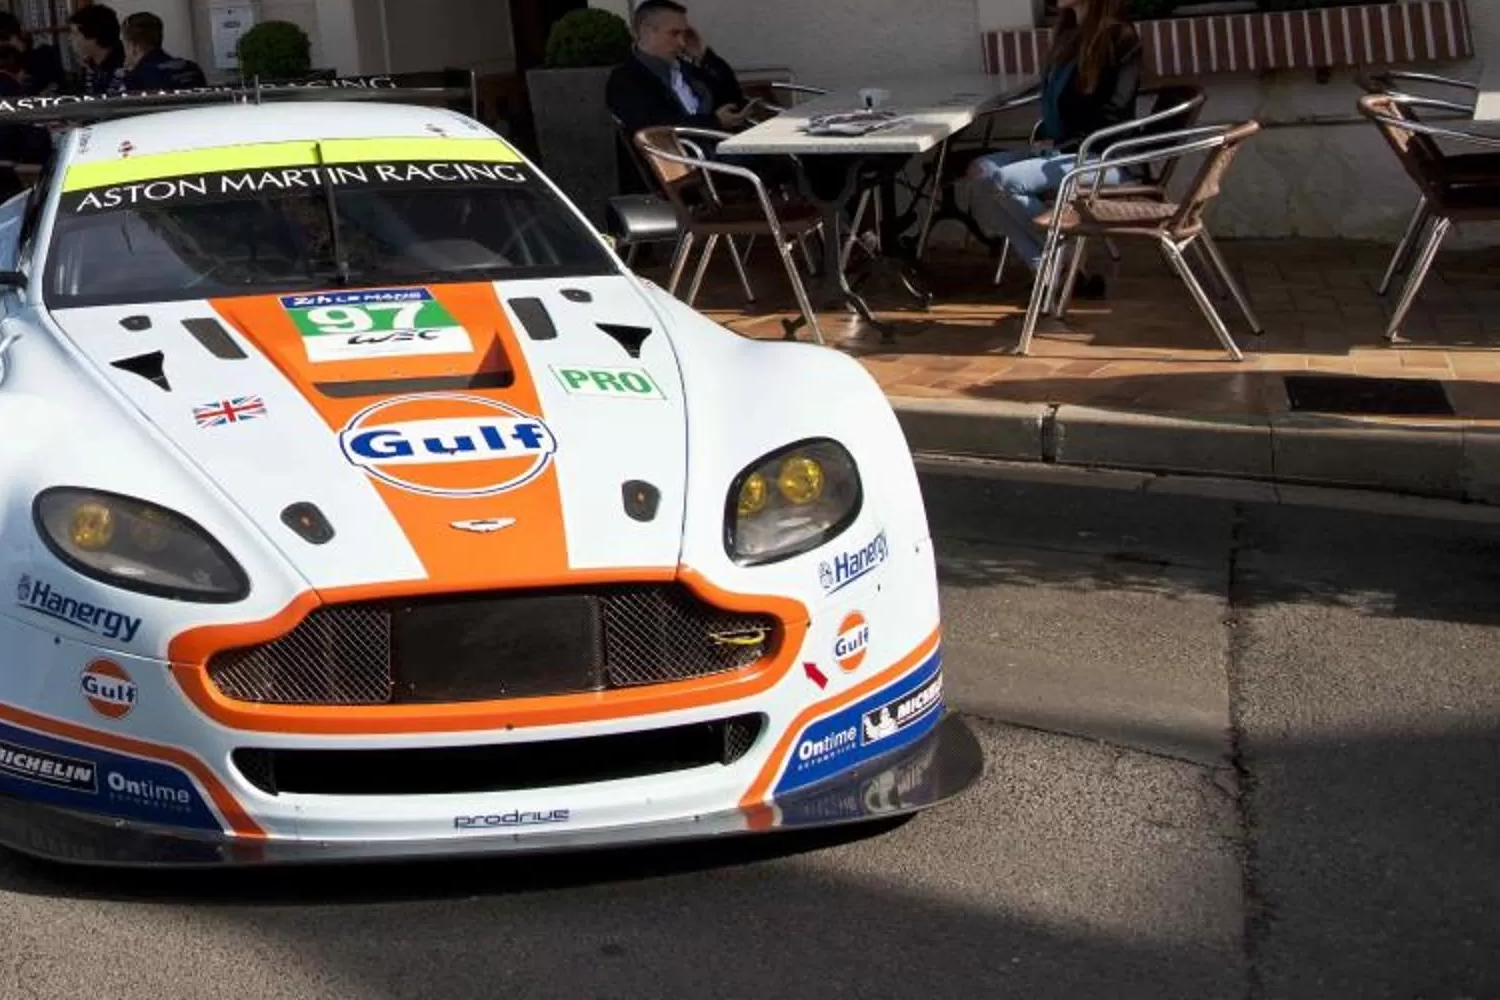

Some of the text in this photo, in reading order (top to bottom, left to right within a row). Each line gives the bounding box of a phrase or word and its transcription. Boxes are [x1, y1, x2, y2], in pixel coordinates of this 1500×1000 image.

[76, 163, 525, 212] ASTON MARTIN RACING
[307, 302, 424, 335] 97
[347, 328, 442, 345] WEC
[560, 370, 652, 393] PRO
[350, 423, 545, 460] Gulf
[30, 580, 143, 643] Hanergy
[835, 627, 868, 656] Gulf
[81, 675, 136, 703] Gulf
[799, 727, 857, 760] Ontime
[107, 771, 190, 803] Ontime
[454, 808, 570, 828] prodrive
